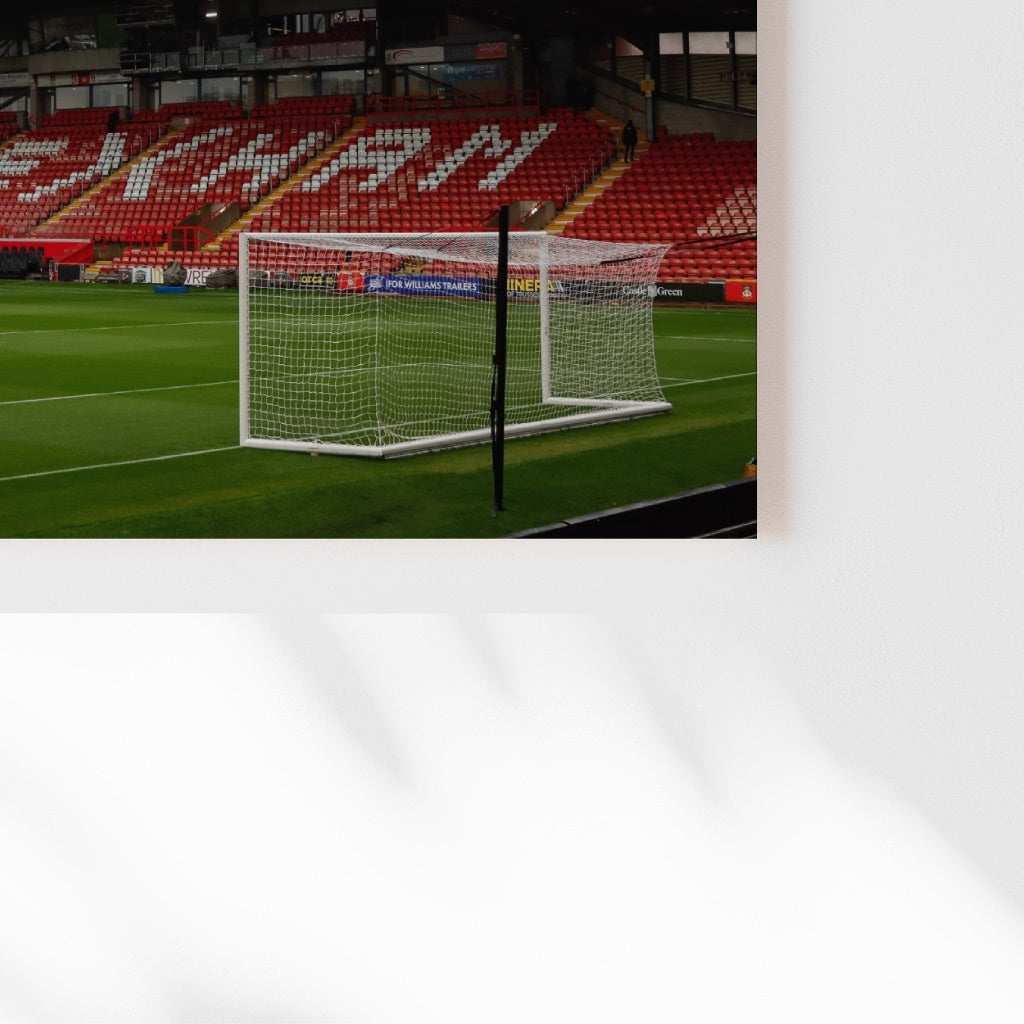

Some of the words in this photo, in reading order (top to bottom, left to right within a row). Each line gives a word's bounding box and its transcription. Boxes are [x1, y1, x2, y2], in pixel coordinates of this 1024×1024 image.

[404, 280, 441, 290] WILLIAMS
[443, 281, 477, 291] TRAILERS
[507, 279, 555, 292] INERA
[622, 285, 647, 295] Castle
[657, 286, 683, 296] Green
